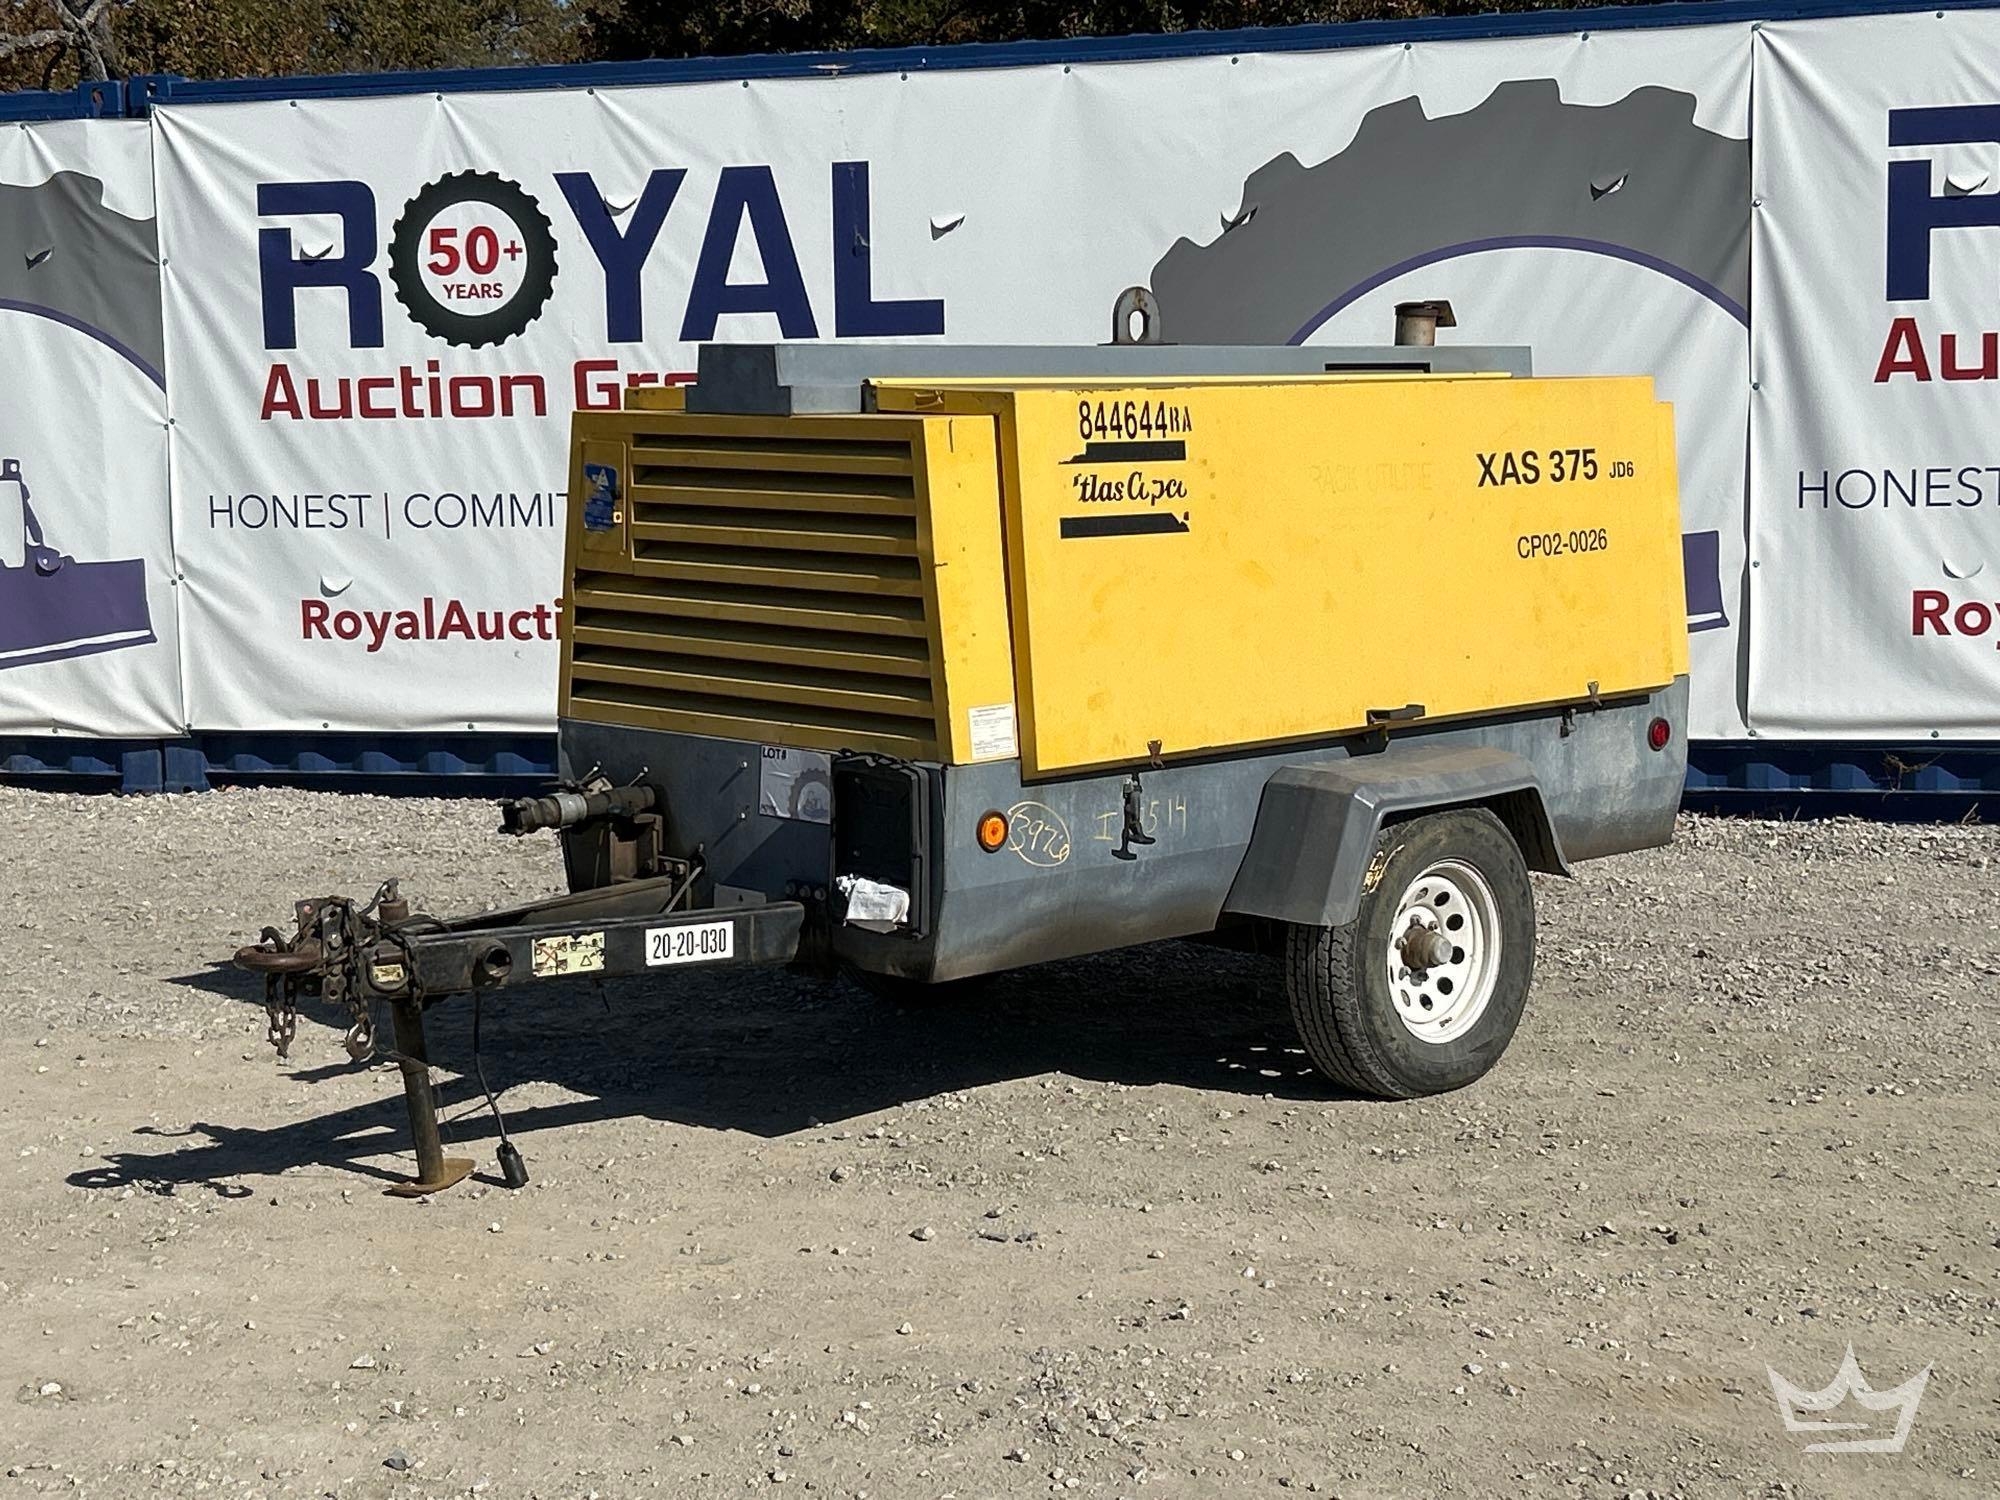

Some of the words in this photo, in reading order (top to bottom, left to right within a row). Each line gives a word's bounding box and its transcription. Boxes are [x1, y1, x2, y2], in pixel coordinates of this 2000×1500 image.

[427, 226, 523, 275] 50+
[442, 282, 504, 300] YEARS
[1874, 317, 1998, 383] Au
[260, 360, 547, 420] Auction
[1476, 449, 1540, 487] XAS
[1549, 448, 1598, 482] 375
[1609, 461, 1634, 479] JD6
[1073, 474, 1125, 502] tlas
[209, 493, 372, 528] HONEST
[1517, 528, 1608, 559] CP02-0026
[1912, 590, 2000, 651] Ro
[653, 928, 727, 959] 20-20-030
